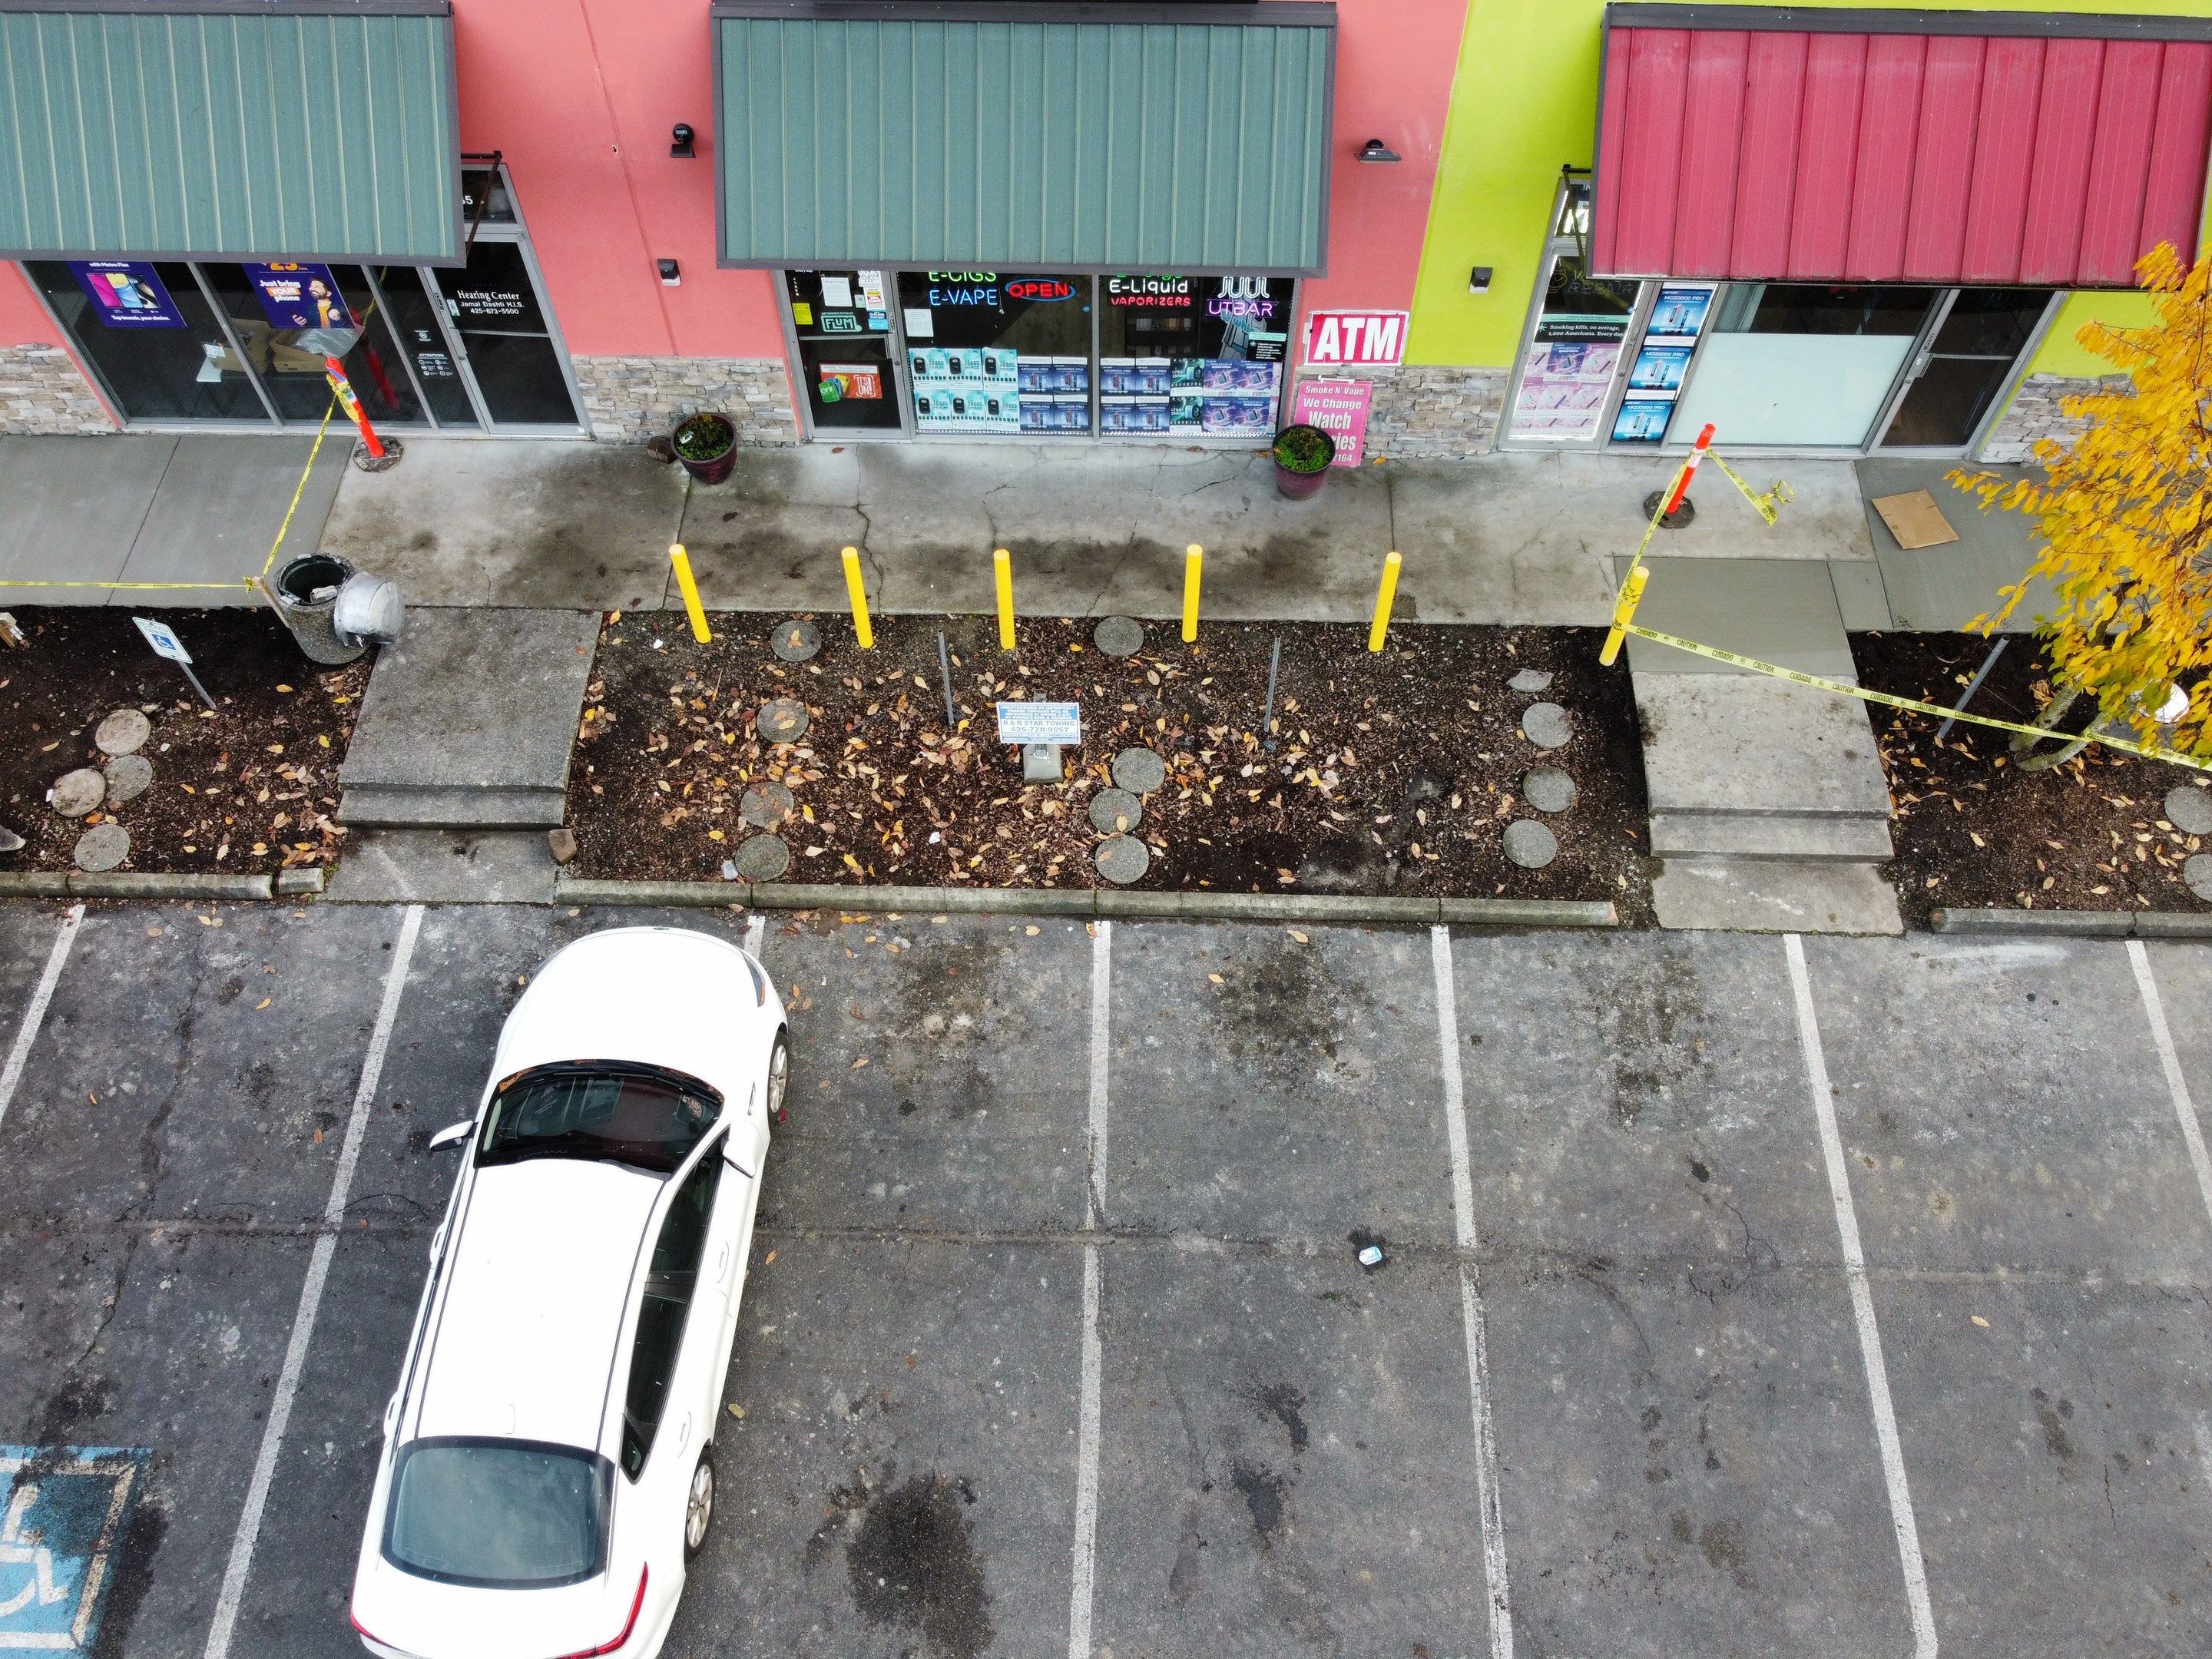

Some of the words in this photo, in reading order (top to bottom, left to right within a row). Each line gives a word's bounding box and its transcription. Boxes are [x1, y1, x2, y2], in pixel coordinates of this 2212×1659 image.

[276, 280, 301, 289] bring
[1008, 282, 1069, 298] OPEN
[1109, 278, 1188, 294] E-Liquid
[1217, 276, 1270, 298] JUUL
[456, 290, 492, 302] Hearing
[929, 289, 998, 306] E-VAPE
[1110, 296, 1191, 307] VAPORIZERS
[1208, 300, 1273, 316] UTBAR
[825, 318, 854, 330] FLUM
[1313, 317, 1400, 361] ATM
[856, 376, 868, 386] IT'S
[1306, 386, 1333, 394] Smoke
[1303, 398, 1320, 407] We
[1323, 398, 1363, 410] Change
[1309, 411, 1352, 429] Watch
[1636, 628, 1658, 639] CUIDADO
[1676, 639, 1698, 651] CAUTION
[1711, 650, 1734, 661] CUIDADO
[1753, 661, 1776, 673] CAUTION
[1789, 671, 1812, 684] CUIDADO
[1832, 683, 1855, 694] CAUTION
[1869, 693, 1893, 704] CUIDADO
[1914, 702, 1938, 714] CAUTION
[1954, 711, 1979, 721] CUIDADO
